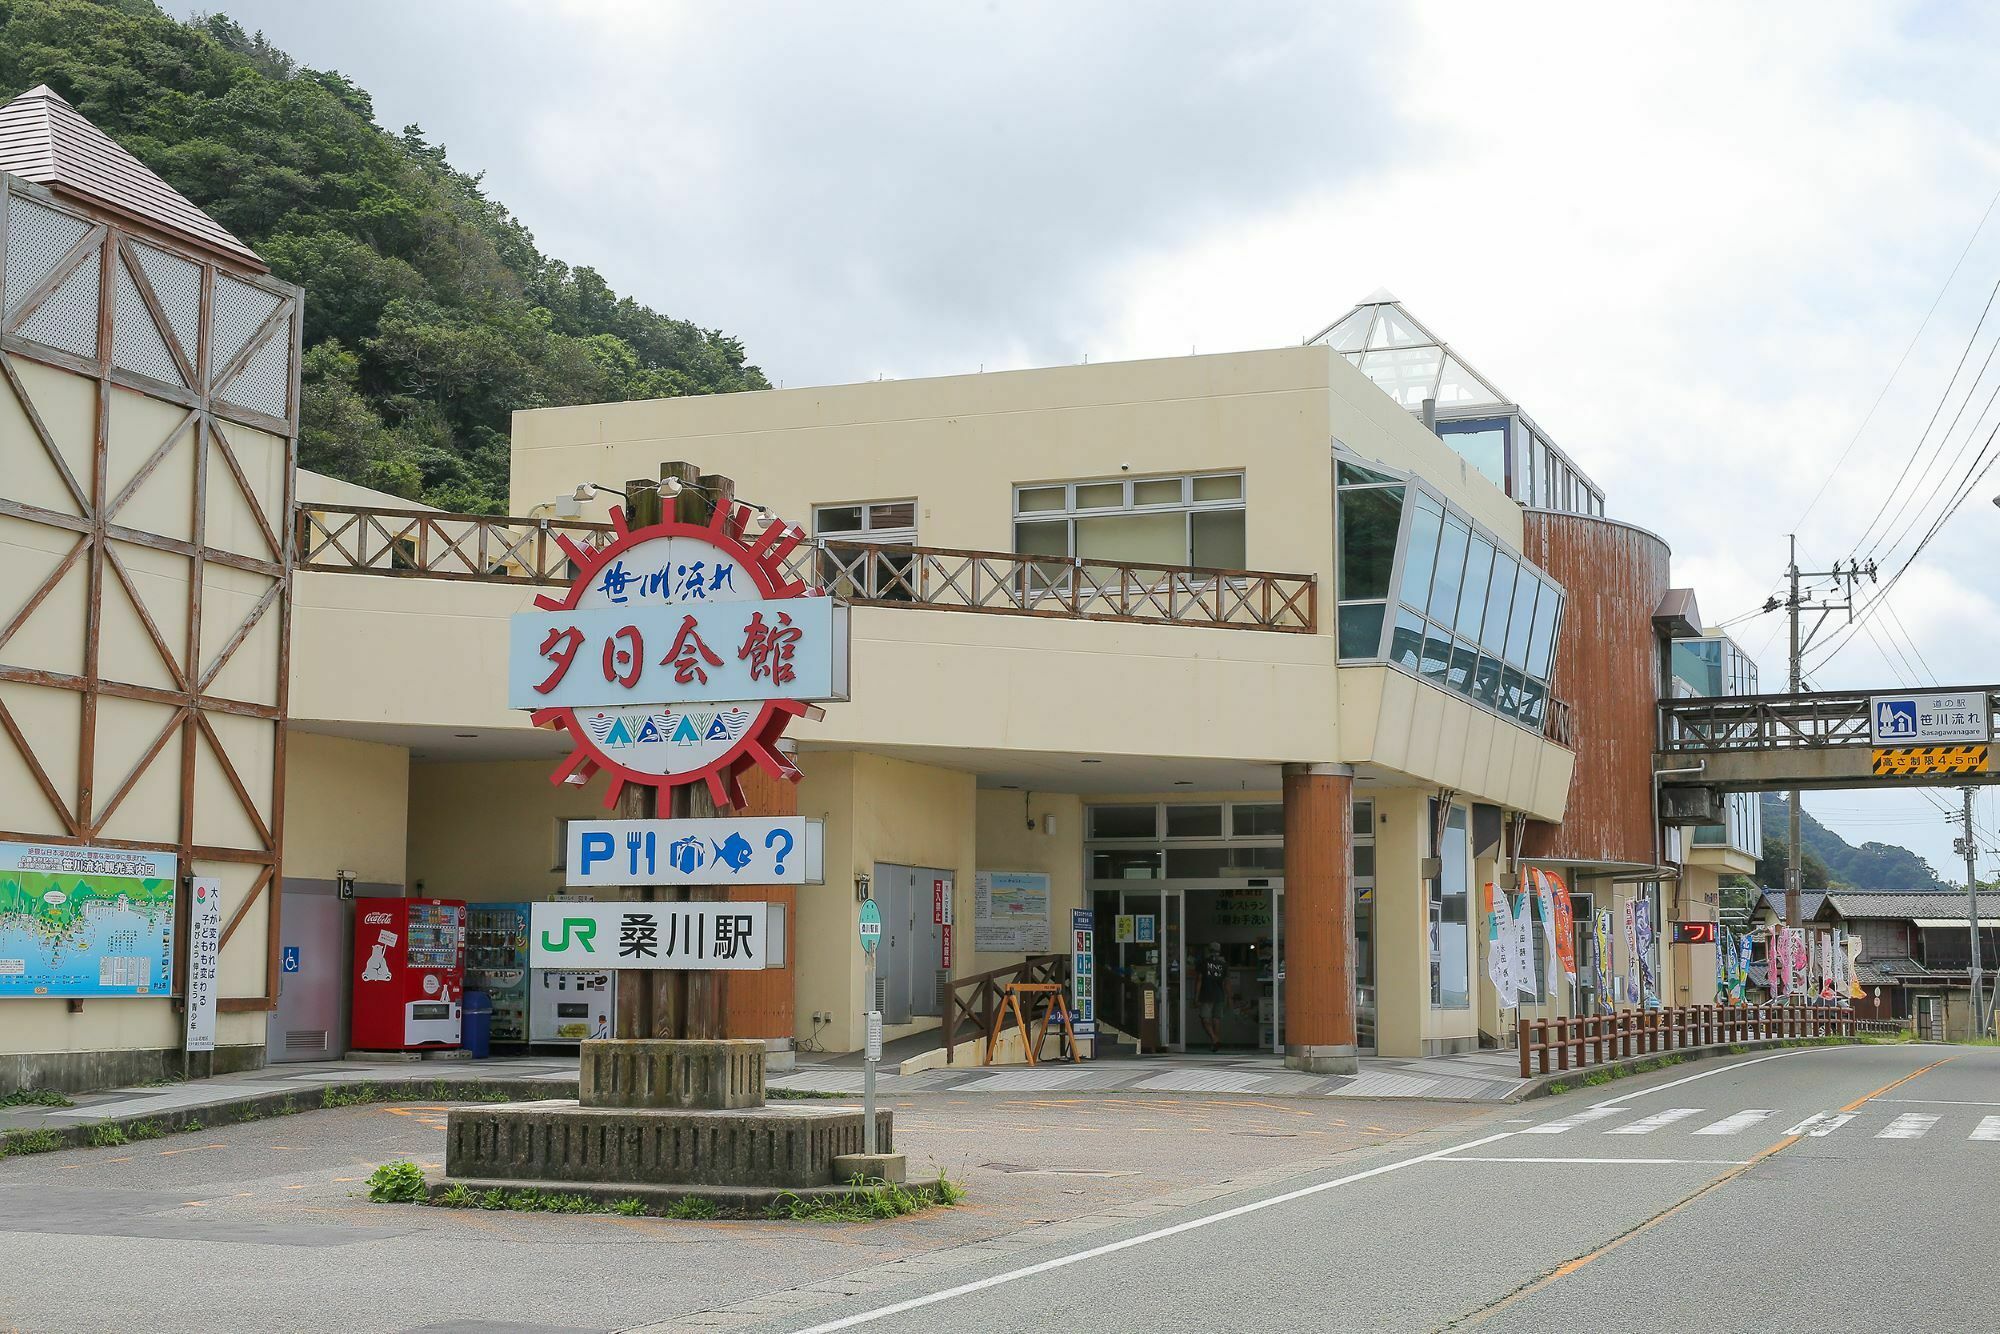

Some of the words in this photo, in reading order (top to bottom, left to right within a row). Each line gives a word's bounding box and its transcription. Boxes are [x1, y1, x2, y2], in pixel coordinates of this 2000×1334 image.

[597, 560, 737, 603] 笹川流れ
[532, 612, 803, 695] 夕日会館
[1920, 713, 1980, 726] 笹川流れ
[1933, 699, 1966, 708] 道の駅
[1921, 729, 1980, 737] Sasagawanagare
[1882, 756, 1980, 767] 高さ制限4.5m
[62, 858, 156, 877] 笹川流れ観光案内図
[581, 832, 615, 875] P
[207, 887, 218, 979] 大人が変われば
[542, 917, 597, 953] JR
[618, 912, 754, 960] 桑川駅
[199, 914, 209, 1006] 子どもも変わる
